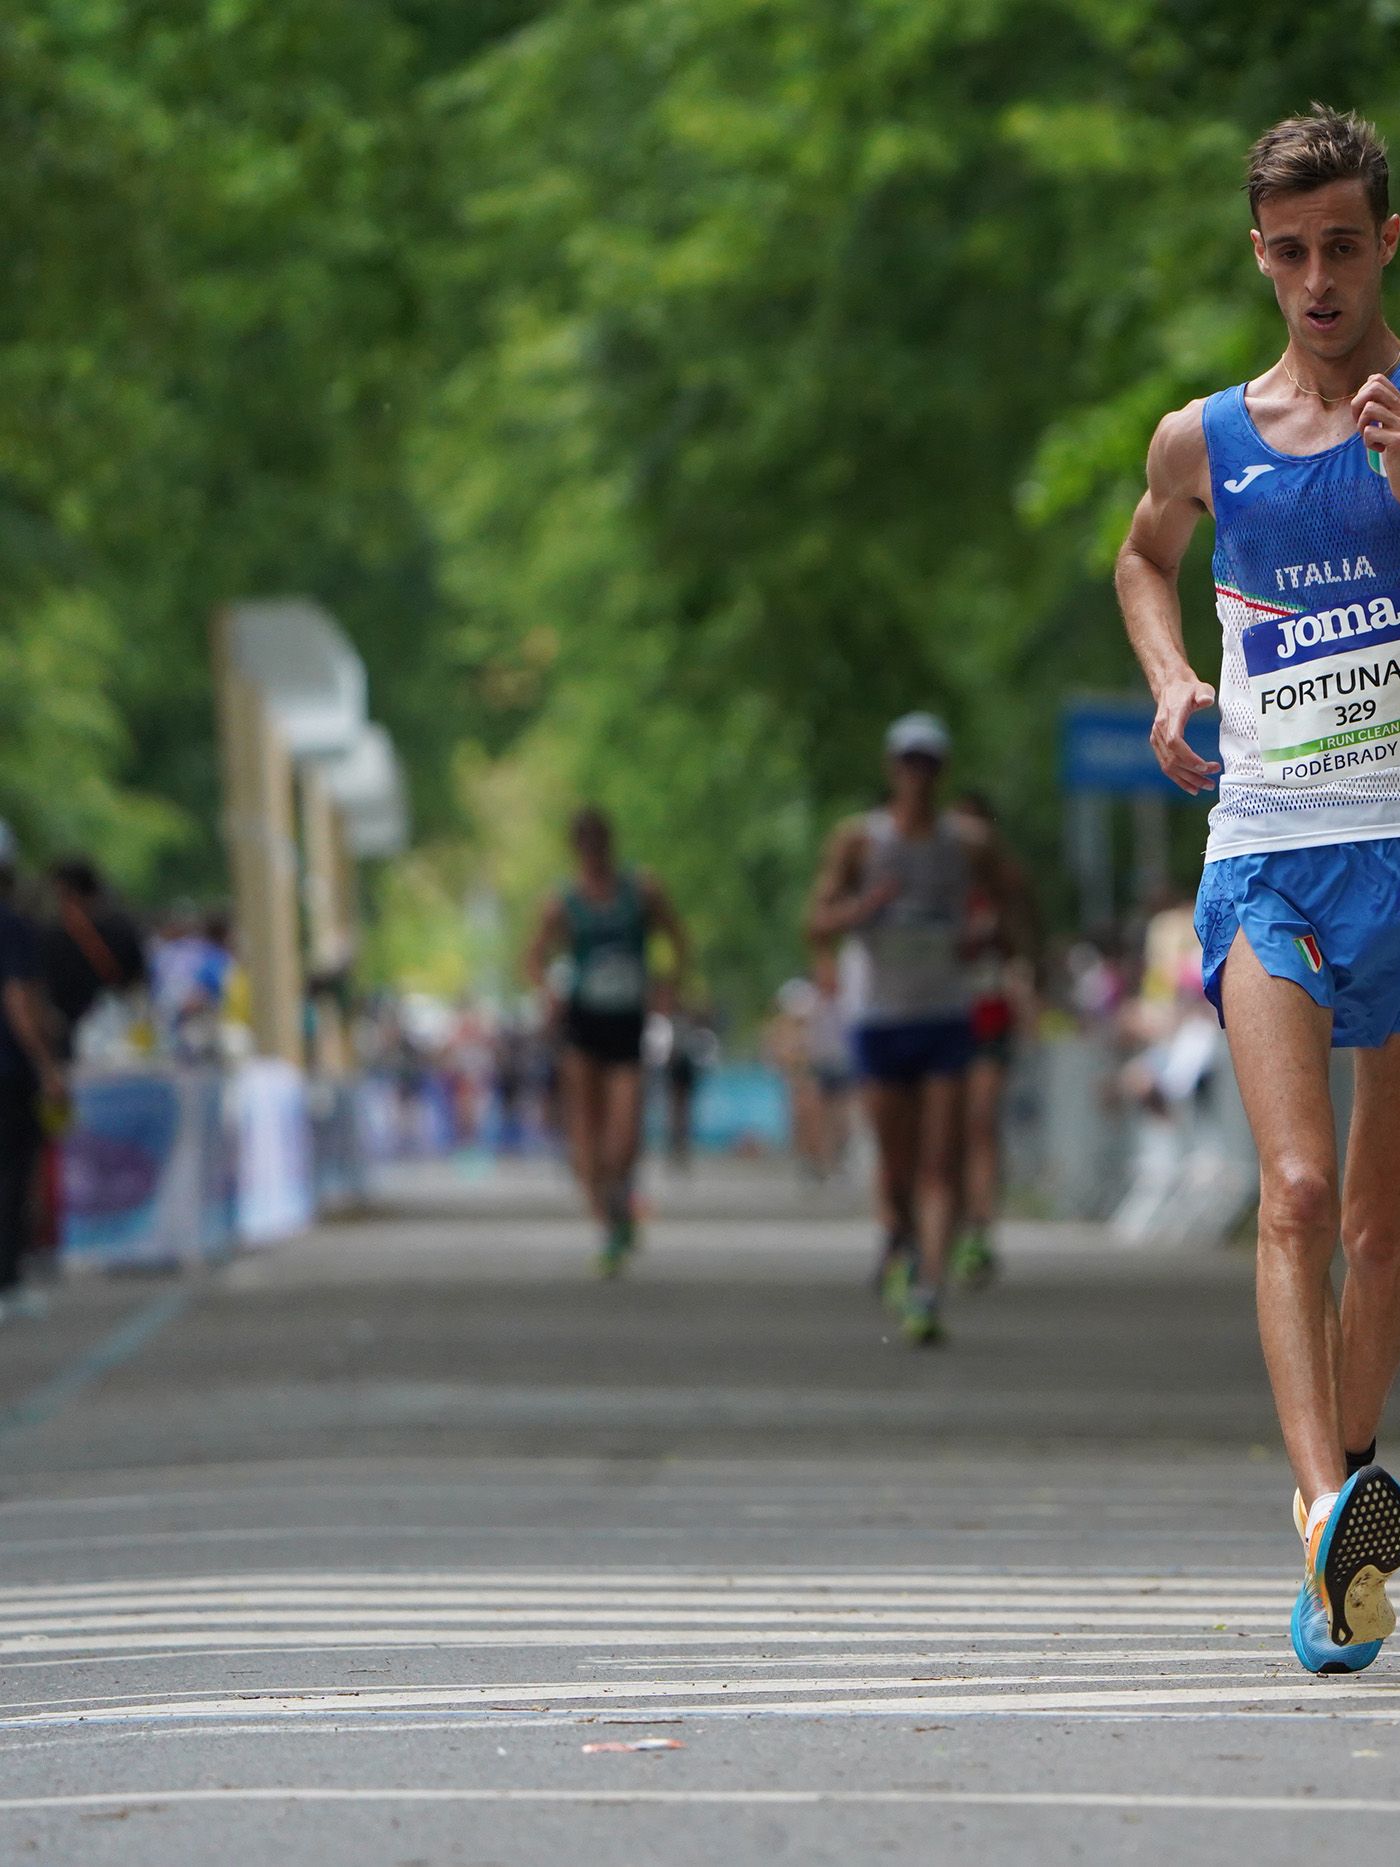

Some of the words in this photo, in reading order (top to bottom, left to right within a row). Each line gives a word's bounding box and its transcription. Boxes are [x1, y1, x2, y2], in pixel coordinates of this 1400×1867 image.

[1275, 555, 1376, 591] ITALIA
[1334, 699, 1377, 727] 329
[1325, 732, 1355, 750] RUN
[1358, 721, 1400, 742] CLEAN
[1282, 741, 1399, 781] PODĚBRADY
